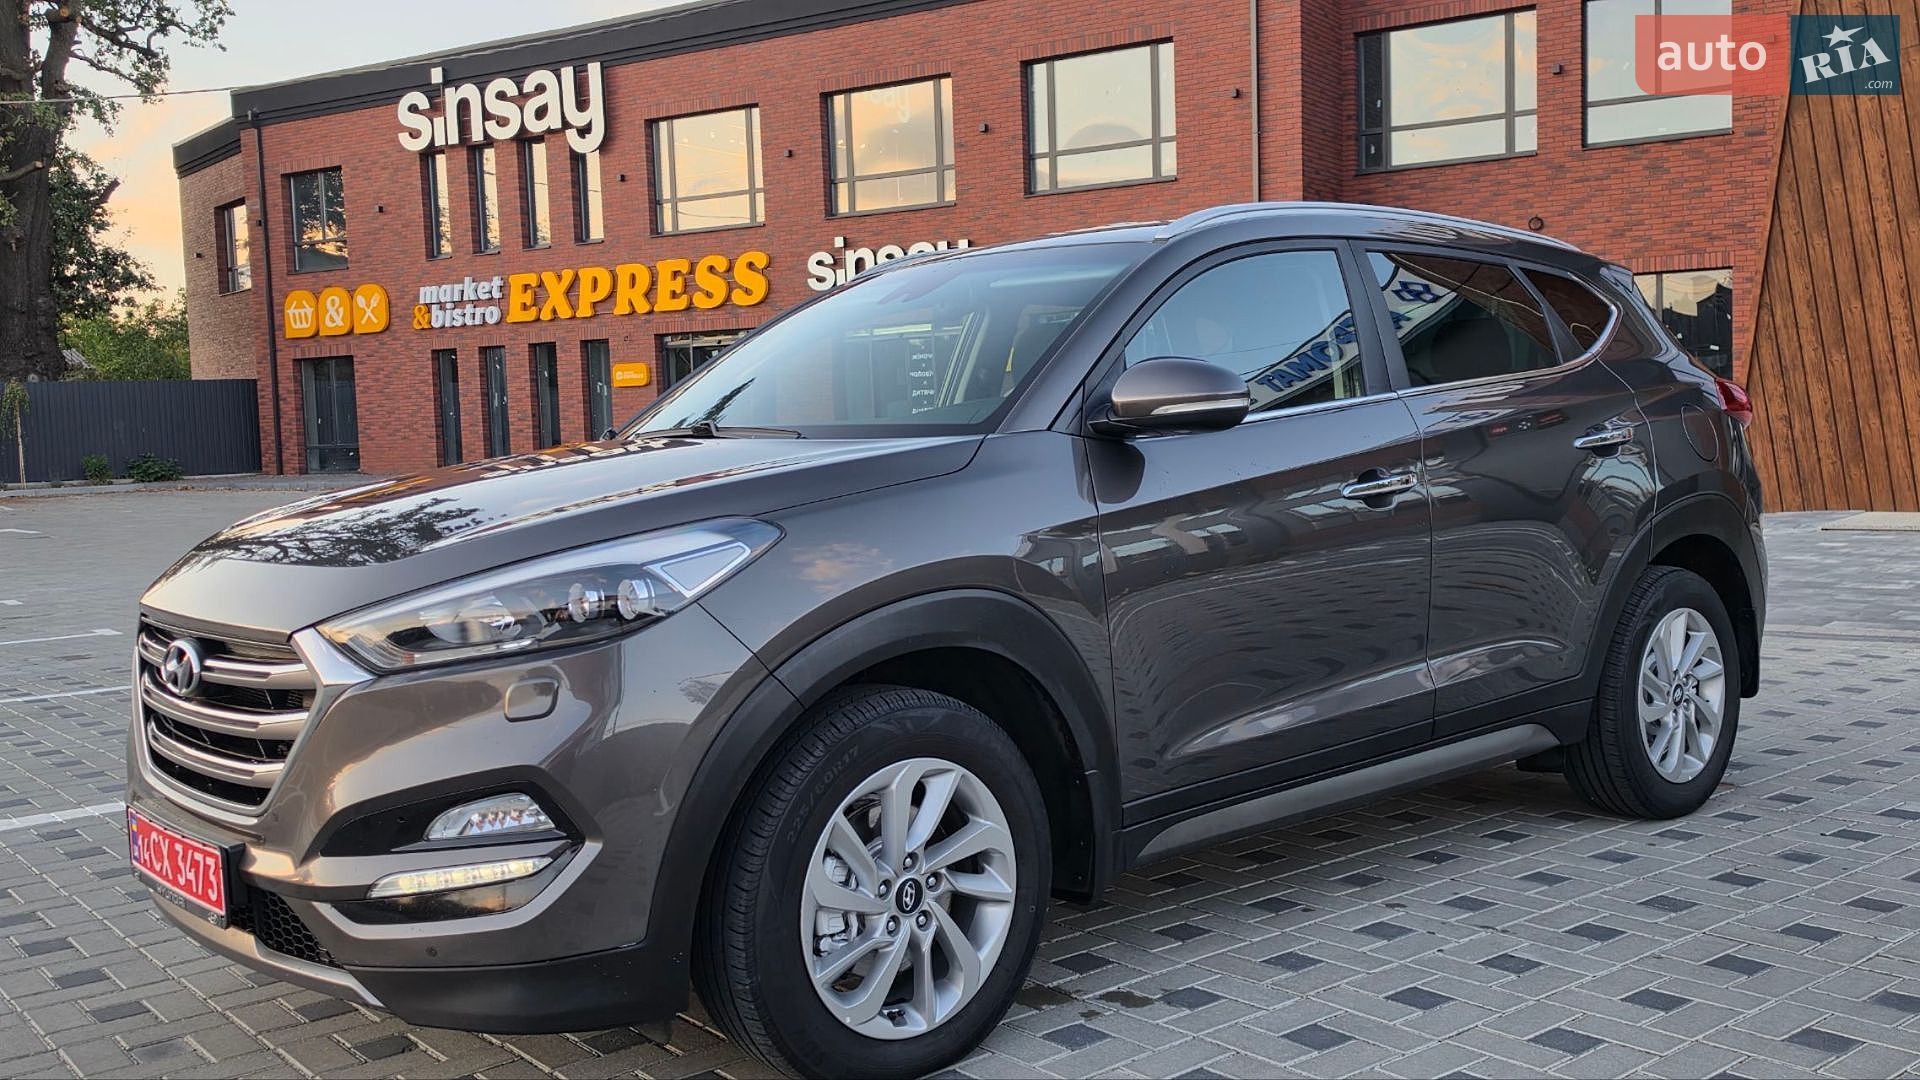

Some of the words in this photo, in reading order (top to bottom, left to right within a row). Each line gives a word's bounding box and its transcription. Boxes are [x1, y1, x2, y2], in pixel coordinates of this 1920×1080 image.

[397, 61, 605, 154] sinsay
[419, 275, 504, 304] market
[506, 251, 770, 324] EXPRESS
[807, 236, 969, 291] sin
[175, 843, 217, 901] 3473
